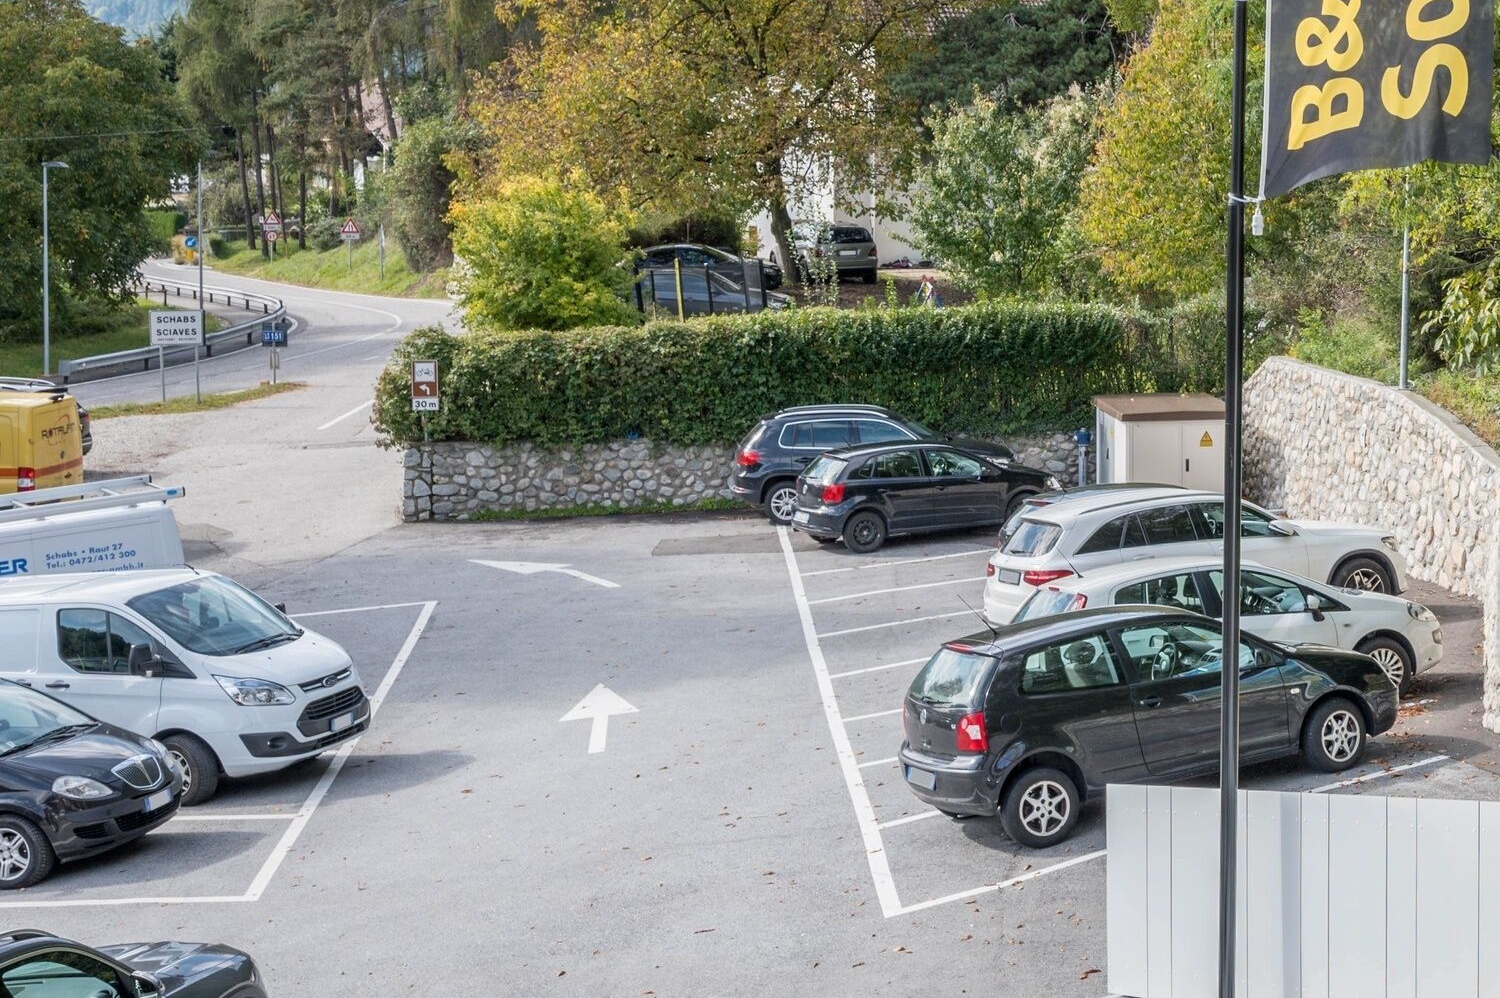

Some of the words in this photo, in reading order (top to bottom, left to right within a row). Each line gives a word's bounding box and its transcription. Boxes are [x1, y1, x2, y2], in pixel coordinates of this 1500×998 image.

[156, 328, 197, 336] SCIAVES
[270, 331, 282, 340] 151
[414, 400, 427, 408] 30
[45, 550, 77, 561] Schabs
[89, 546, 110, 555] Raut
[112, 543, 123, 551] 27
[46, 561, 66, 570] Tel.:
[69, 553, 115, 566] 0472/412
[118, 550, 137, 559] 300
